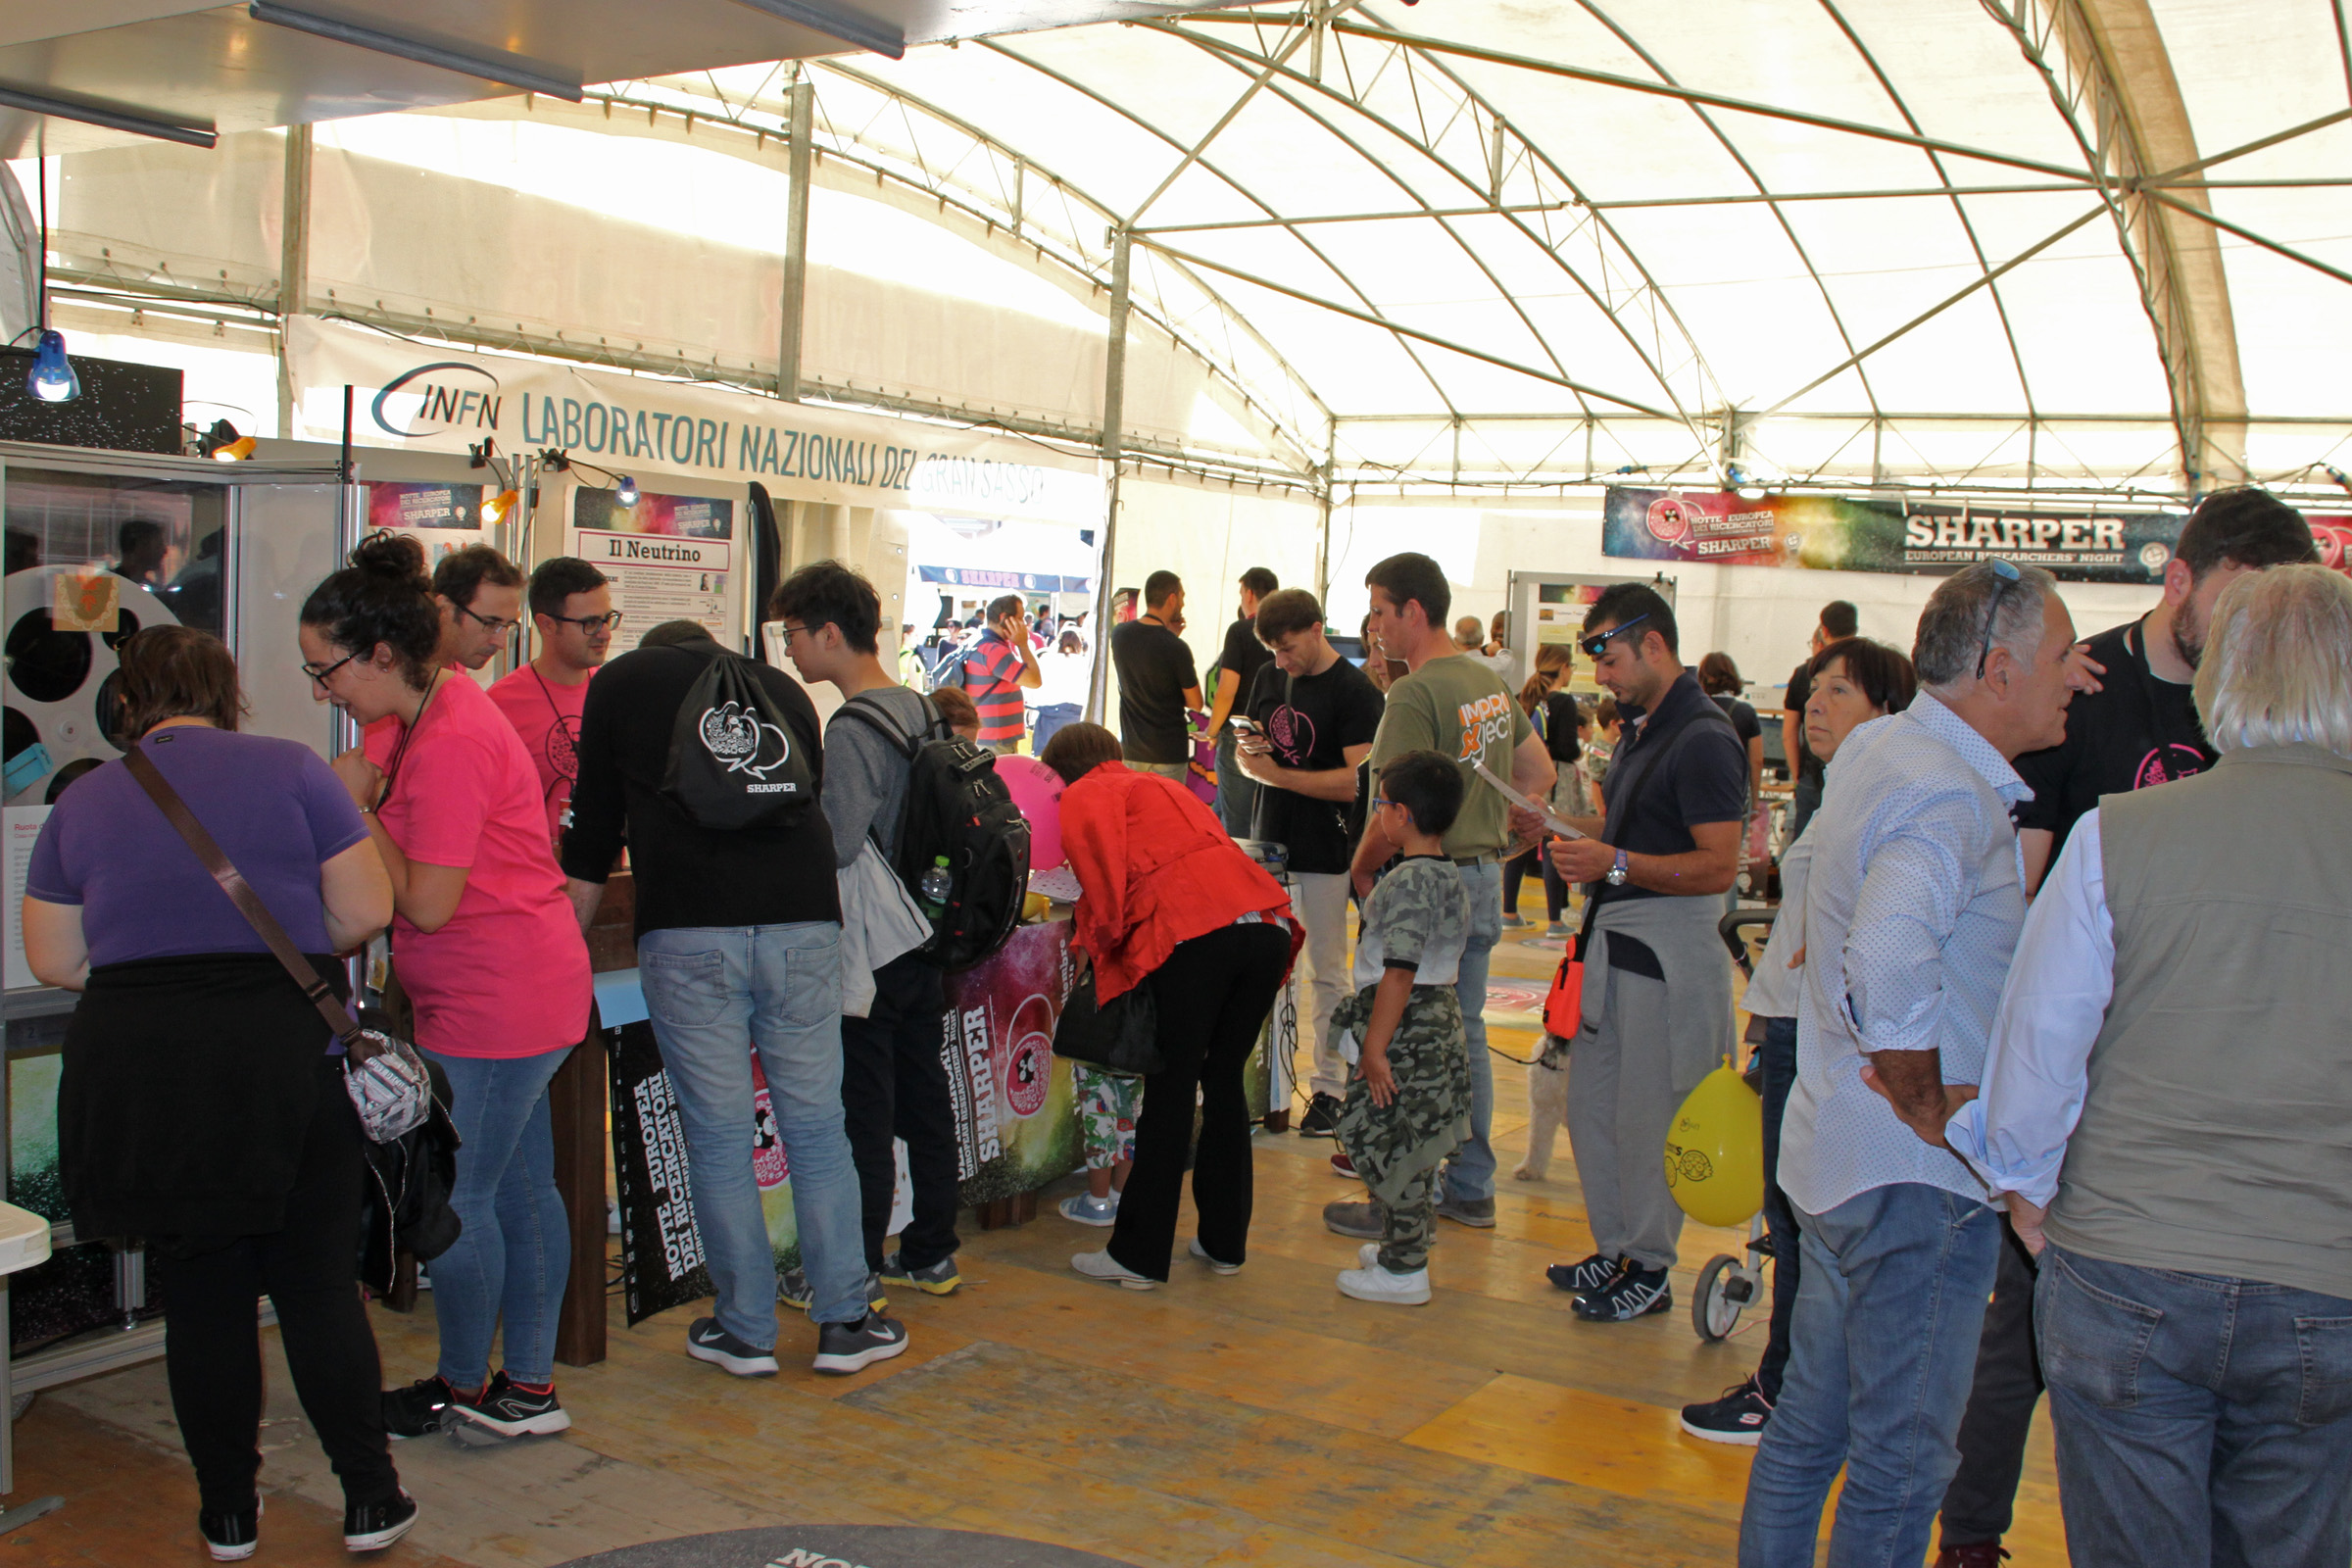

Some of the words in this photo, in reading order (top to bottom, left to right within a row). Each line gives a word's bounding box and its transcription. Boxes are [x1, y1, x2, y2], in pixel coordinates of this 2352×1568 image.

[419, 383, 502, 430] INFN
[522, 392, 729, 470] LABORATORI
[739, 424, 877, 487] NAZIONALI
[880, 446, 919, 491] DEL
[922, 452, 976, 495] GRAN
[981, 459, 1044, 505] SASSO
[404, 508, 451, 520] SHARPER
[1690, 515, 1722, 525] NOTTE
[1728, 511, 1774, 522] EUROPEA
[1710, 518, 1774, 531] RICERCATORI
[1697, 536, 1771, 556] SHARPER
[1905, 514, 2126, 550] SHARPER
[609, 539, 622, 557] Il
[627, 541, 701, 562] Neutrino
[1905, 550, 1974, 562] EUROPEAN
[2080, 553, 2124, 564] NIGHT
[960, 569, 1020, 588] SHARPER
[747, 783, 796, 793] SHARPER
[949, 1008, 957, 1042] NIGHT
[950, 1044, 969, 1121] RESEARCHERS'
[963, 1004, 1001, 1163] SHARPER
[633, 1078, 666, 1193] EUROPEA
[648, 1071, 690, 1228] RICERCATORI
[960, 1122, 975, 1178] EUROPEAN
[657, 1201, 684, 1282] NOTTE
[677, 1227, 699, 1272] DEI
